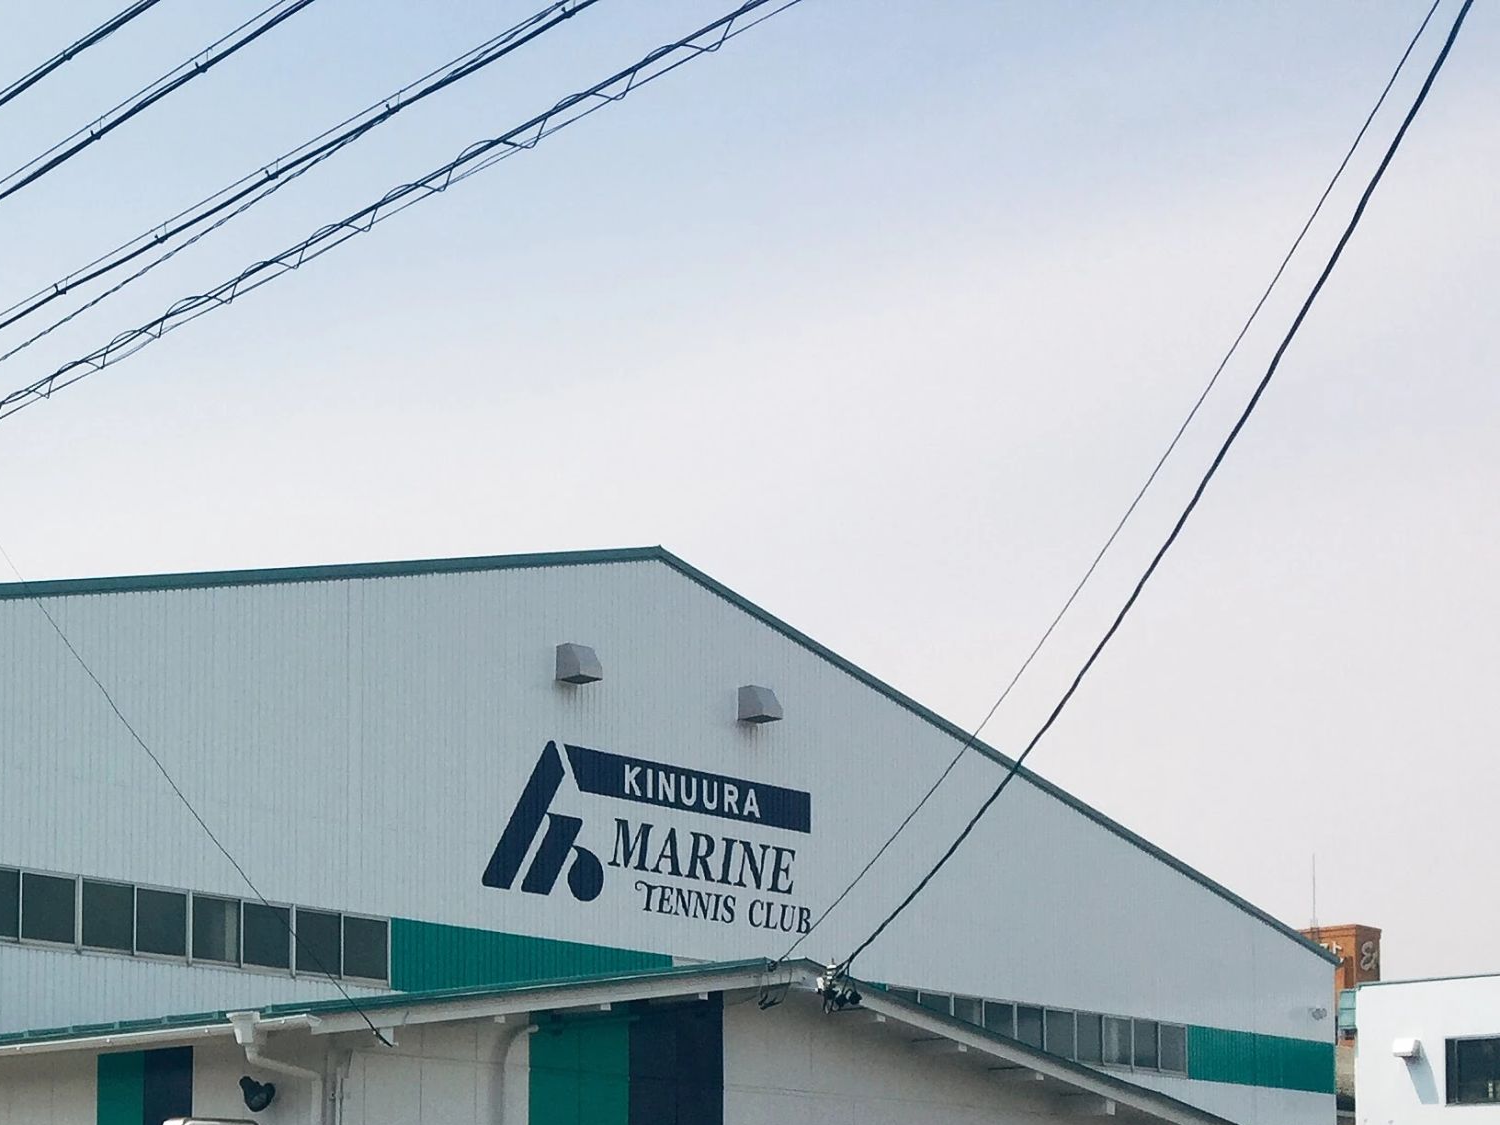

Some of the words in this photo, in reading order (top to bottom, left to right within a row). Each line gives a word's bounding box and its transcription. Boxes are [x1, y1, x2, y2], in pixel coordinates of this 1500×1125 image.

[623, 764, 762, 819] KINUURA
[607, 818, 796, 895] MARINE
[634, 880, 736, 924] TENNIS
[748, 899, 812, 935] CLUB
